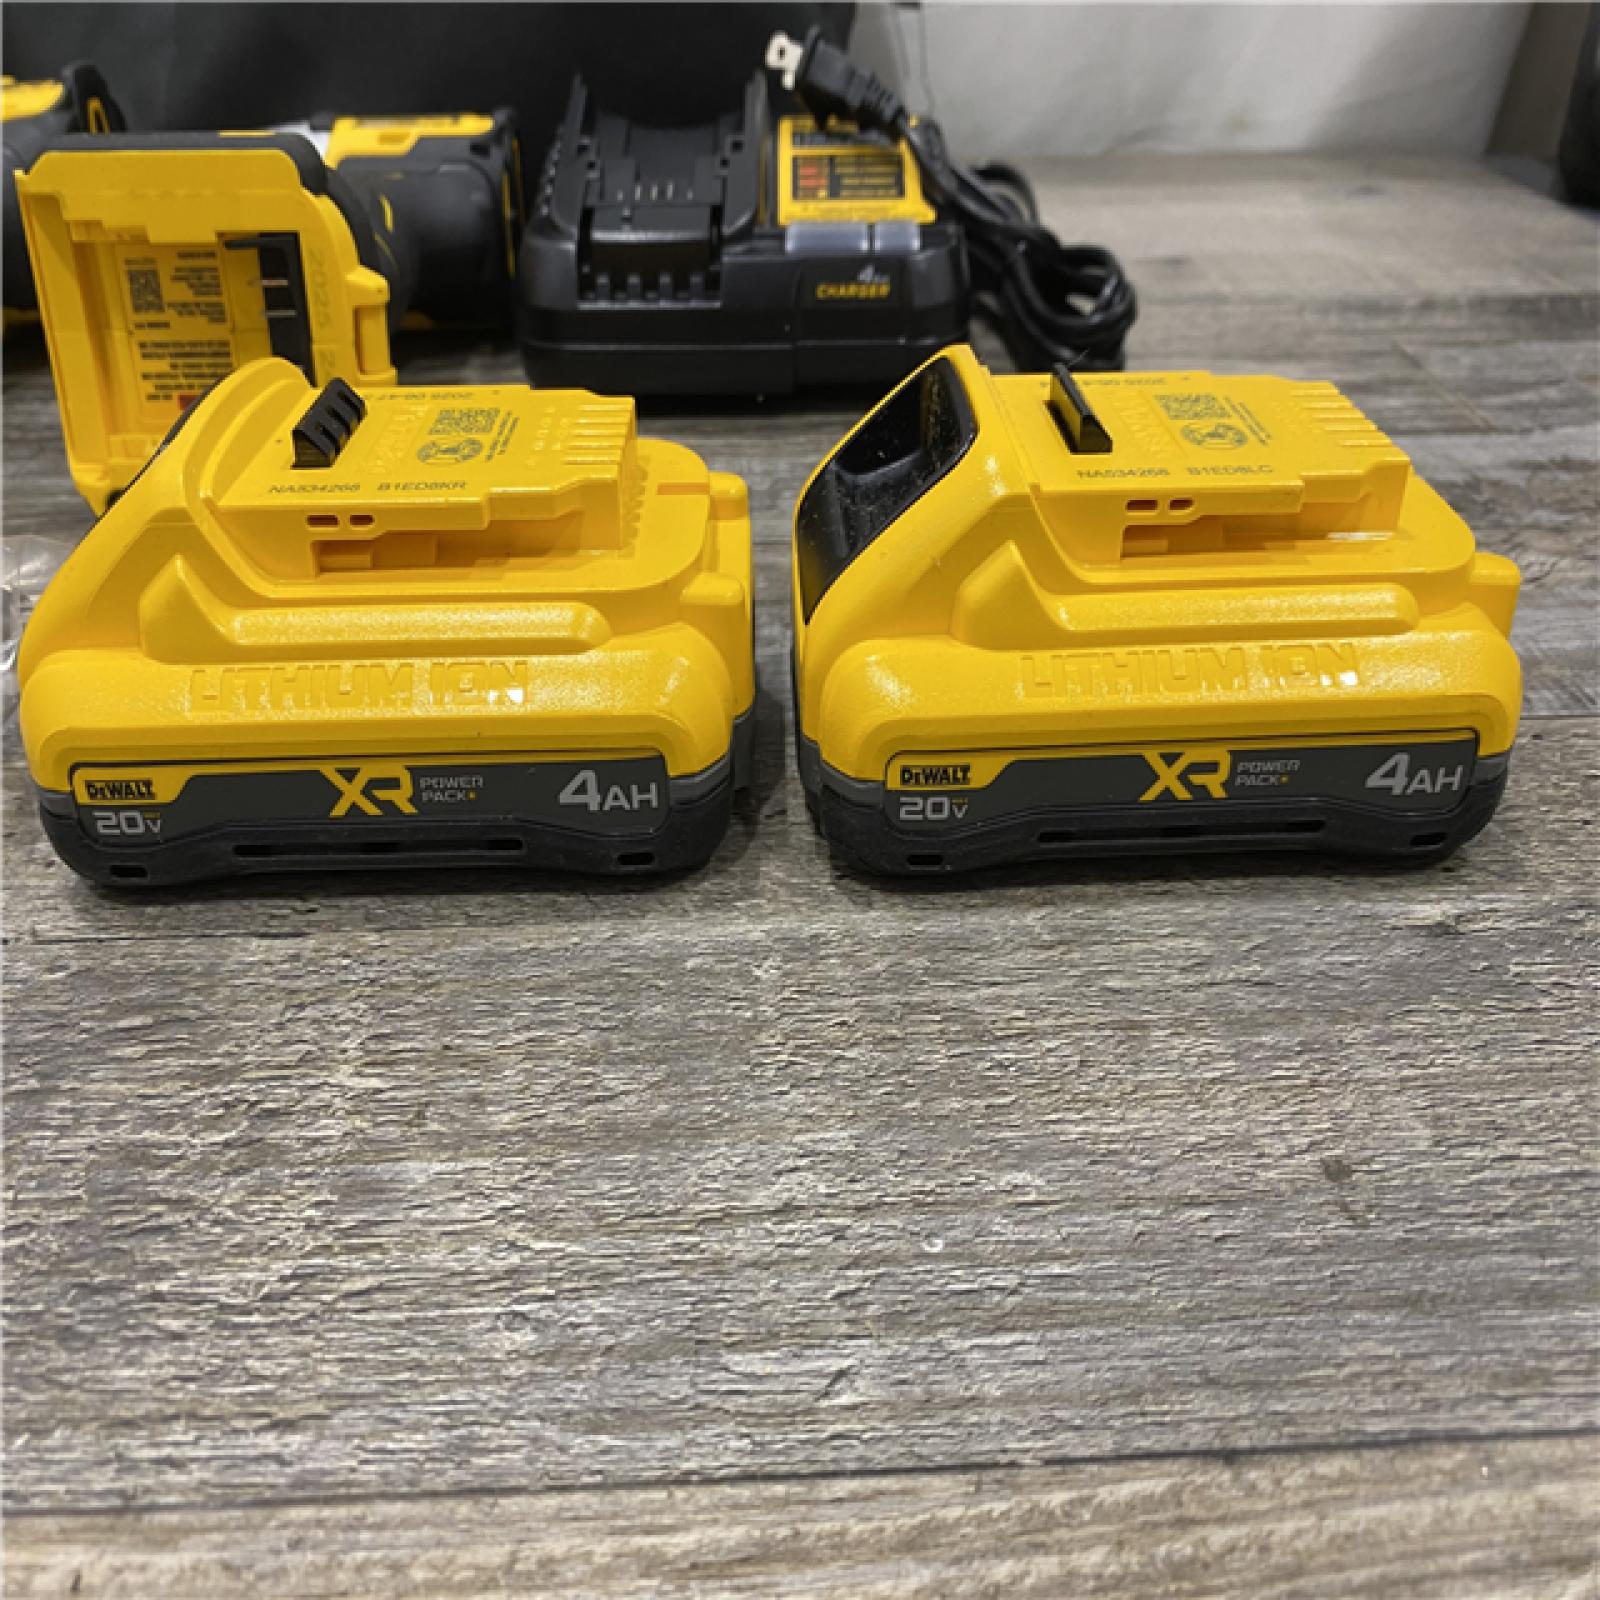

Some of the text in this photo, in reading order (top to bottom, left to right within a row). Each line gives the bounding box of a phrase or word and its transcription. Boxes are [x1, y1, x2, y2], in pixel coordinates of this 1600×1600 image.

[188, 659, 529, 712] LITHIUM ION
[1017, 642, 1362, 701] LITHIUM ION
[322, 765, 418, 817] XR
[419, 775, 484, 789] POWER
[1137, 750, 1233, 801] XR
[1236, 759, 1301, 774] POWER
